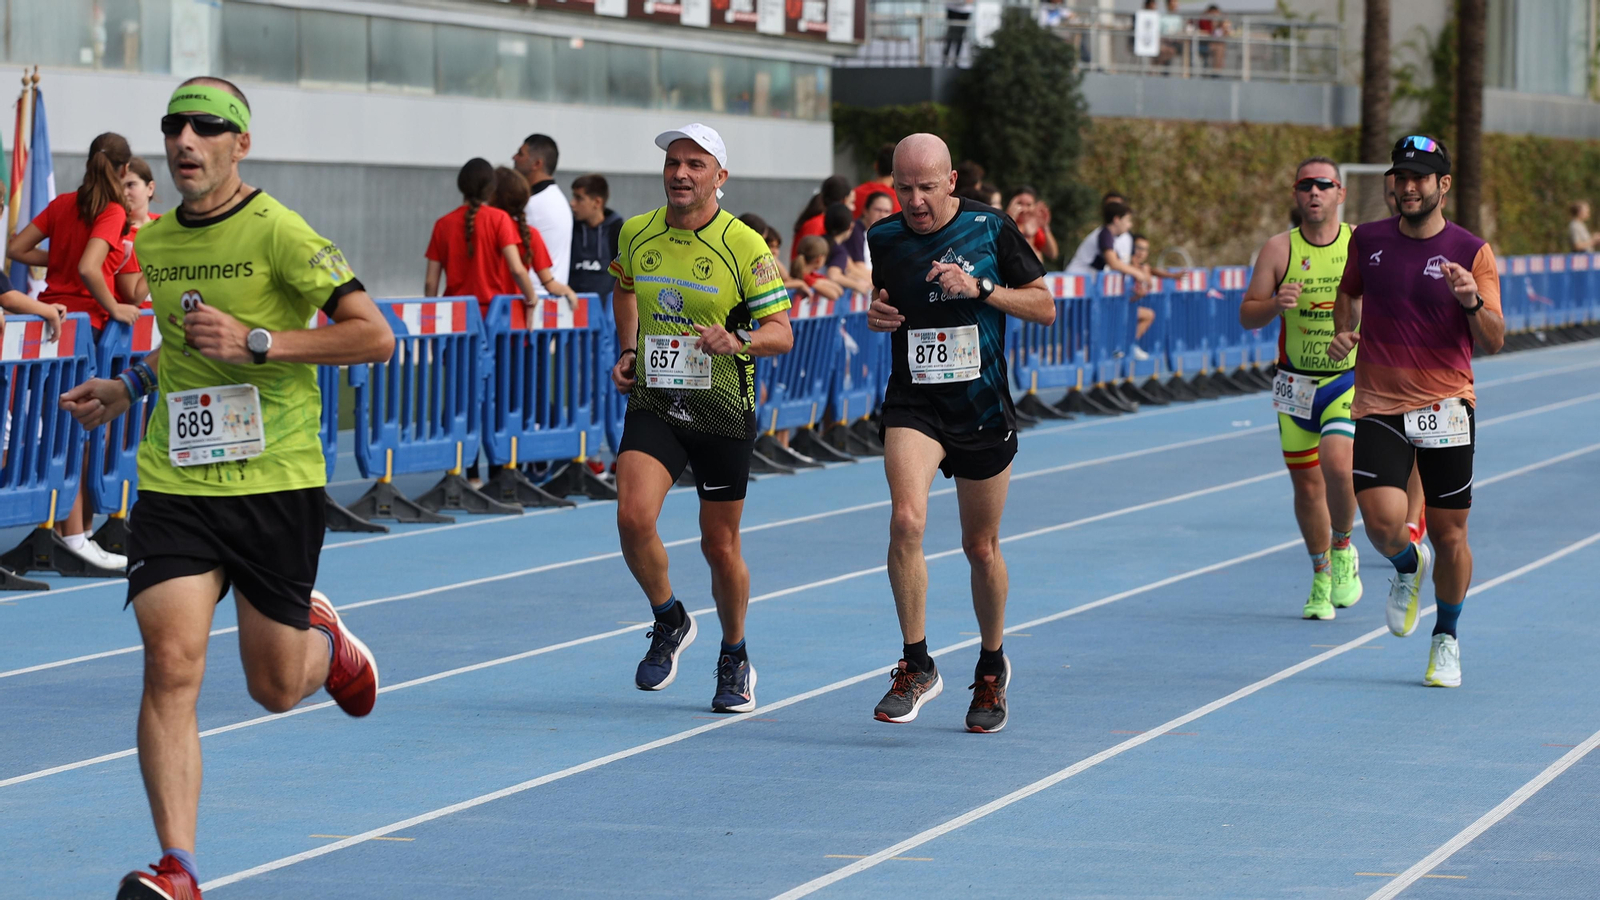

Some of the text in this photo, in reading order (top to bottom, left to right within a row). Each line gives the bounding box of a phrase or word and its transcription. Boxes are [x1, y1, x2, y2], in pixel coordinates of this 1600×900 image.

[676, 280, 719, 294] CLIMATIZACIÓN
[1301, 286, 1332, 294] UERTO
[653, 313, 693, 326] VENTURA
[1306, 328, 1336, 337] infisp
[915, 344, 948, 364] 878
[1302, 340, 1331, 355] VICT
[650, 350, 680, 369] 657
[1300, 355, 1350, 369] MIRANDA
[1275, 381, 1293, 399] 908
[177, 409, 214, 439] 689
[1417, 414, 1438, 431] 68
